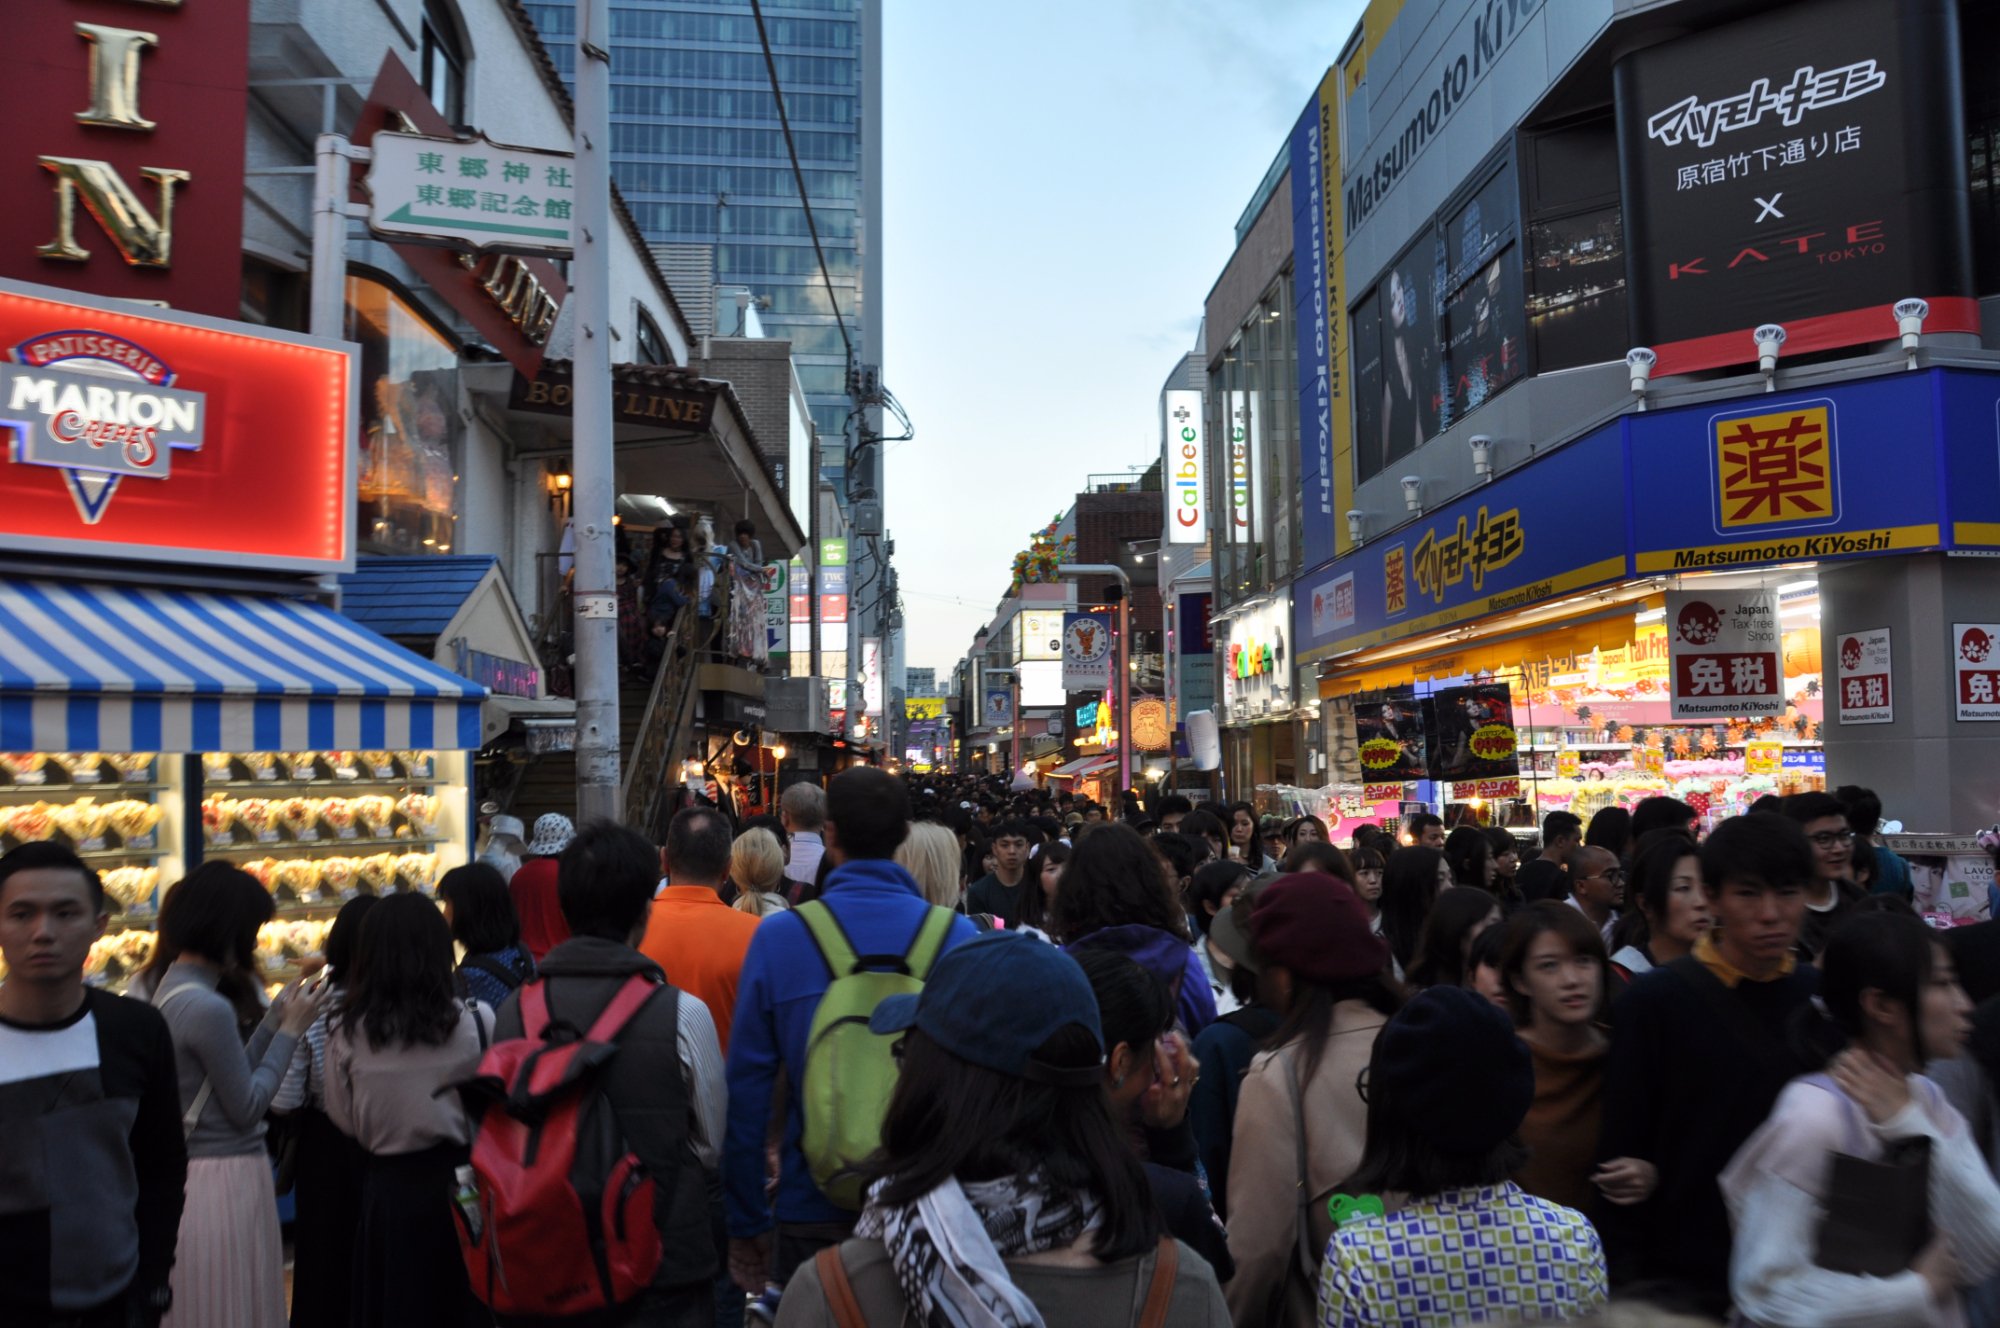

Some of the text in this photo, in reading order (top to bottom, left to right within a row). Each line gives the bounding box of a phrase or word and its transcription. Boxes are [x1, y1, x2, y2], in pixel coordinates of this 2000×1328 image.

[1648, 59, 1886, 147] マツモトキヨシ
[1346, 53, 1467, 237] Matsumoto
[1677, 126, 1861, 191] 原宿竹下通り店
[416, 152, 573, 188] 東郷神社
[416, 184, 573, 220] 東郷記念館
[1322, 104, 1334, 279] Matsumoto
[1816, 242, 1886, 264] TOKYO
[1308, 125, 1331, 513] Matsumoto KiYoshi
[32, 337, 162, 378] PATISSERIE
[8, 375, 197, 433] MARION
[624, 392, 704, 423] LINE
[1176, 426, 1199, 527] Calbee
[1722, 415, 1826, 521] 薬
[1413, 506, 1523, 602] マツモトキヨシ
[1673, 531, 1892, 568] Matsumoto KiYoshi
[1385, 554, 1405, 612] 薬
[1488, 593, 1525, 612] Matsumoto
[1730, 618, 1774, 630] Tax-free
[1747, 630, 1775, 643] Shop
[1230, 636, 1273, 680] Calbee
[1688, 656, 1767, 696] 免税
[1847, 678, 1884, 708] 免税
[1968, 673, 2000, 703] 免
[1678, 701, 1779, 714] Matsumoto KiYoshi
[1365, 784, 1402, 800] 全品OK
[1477, 780, 1520, 798] 全品OK
